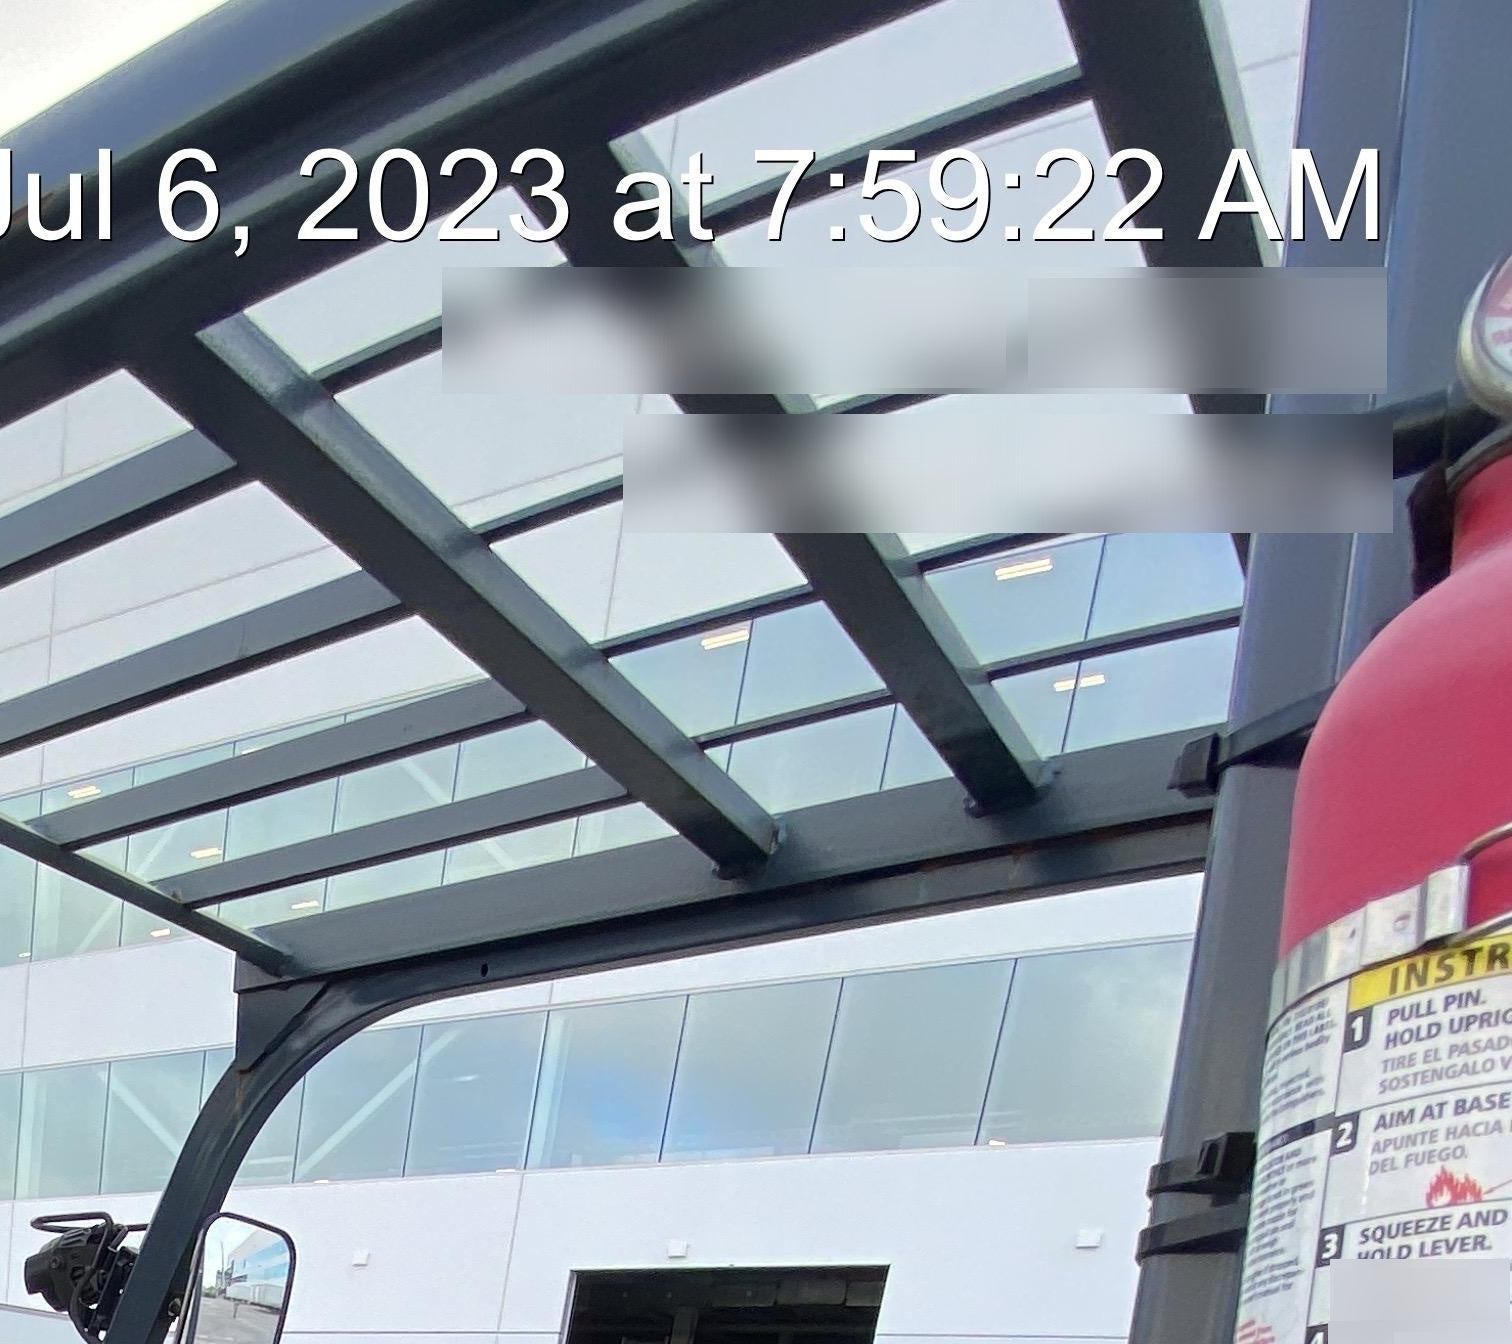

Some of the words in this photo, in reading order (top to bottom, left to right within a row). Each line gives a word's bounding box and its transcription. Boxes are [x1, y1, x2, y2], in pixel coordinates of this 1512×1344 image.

[1386, 995, 1437, 1026] PULL
[1443, 988, 1489, 1012] PIN.
[1351, 1015, 1364, 1043] 1
[1384, 1022, 1442, 1051] HOLD
[1381, 1051, 1418, 1075] TIRE
[1422, 1047, 1442, 1064] EL
[1447, 1035, 1512, 1060] PASAD
[1378, 1059, 1496, 1095] SOSTENGALO
[1373, 1109, 1415, 1132] AIM
[1420, 1101, 1448, 1121] AT
[1453, 1092, 1512, 1116] BASE
[1336, 1120, 1353, 1149] 2
[1371, 1127, 1440, 1156] APUNTE
[1445, 1121, 1503, 1142] HACIA
[1369, 1156, 1399, 1176] DEL
[1359, 1215, 1453, 1245] SQUEEZE
[1457, 1208, 1508, 1230] AND
[1321, 1231, 1340, 1259] 3
[1418, 1234, 1494, 1258] LEVER.
